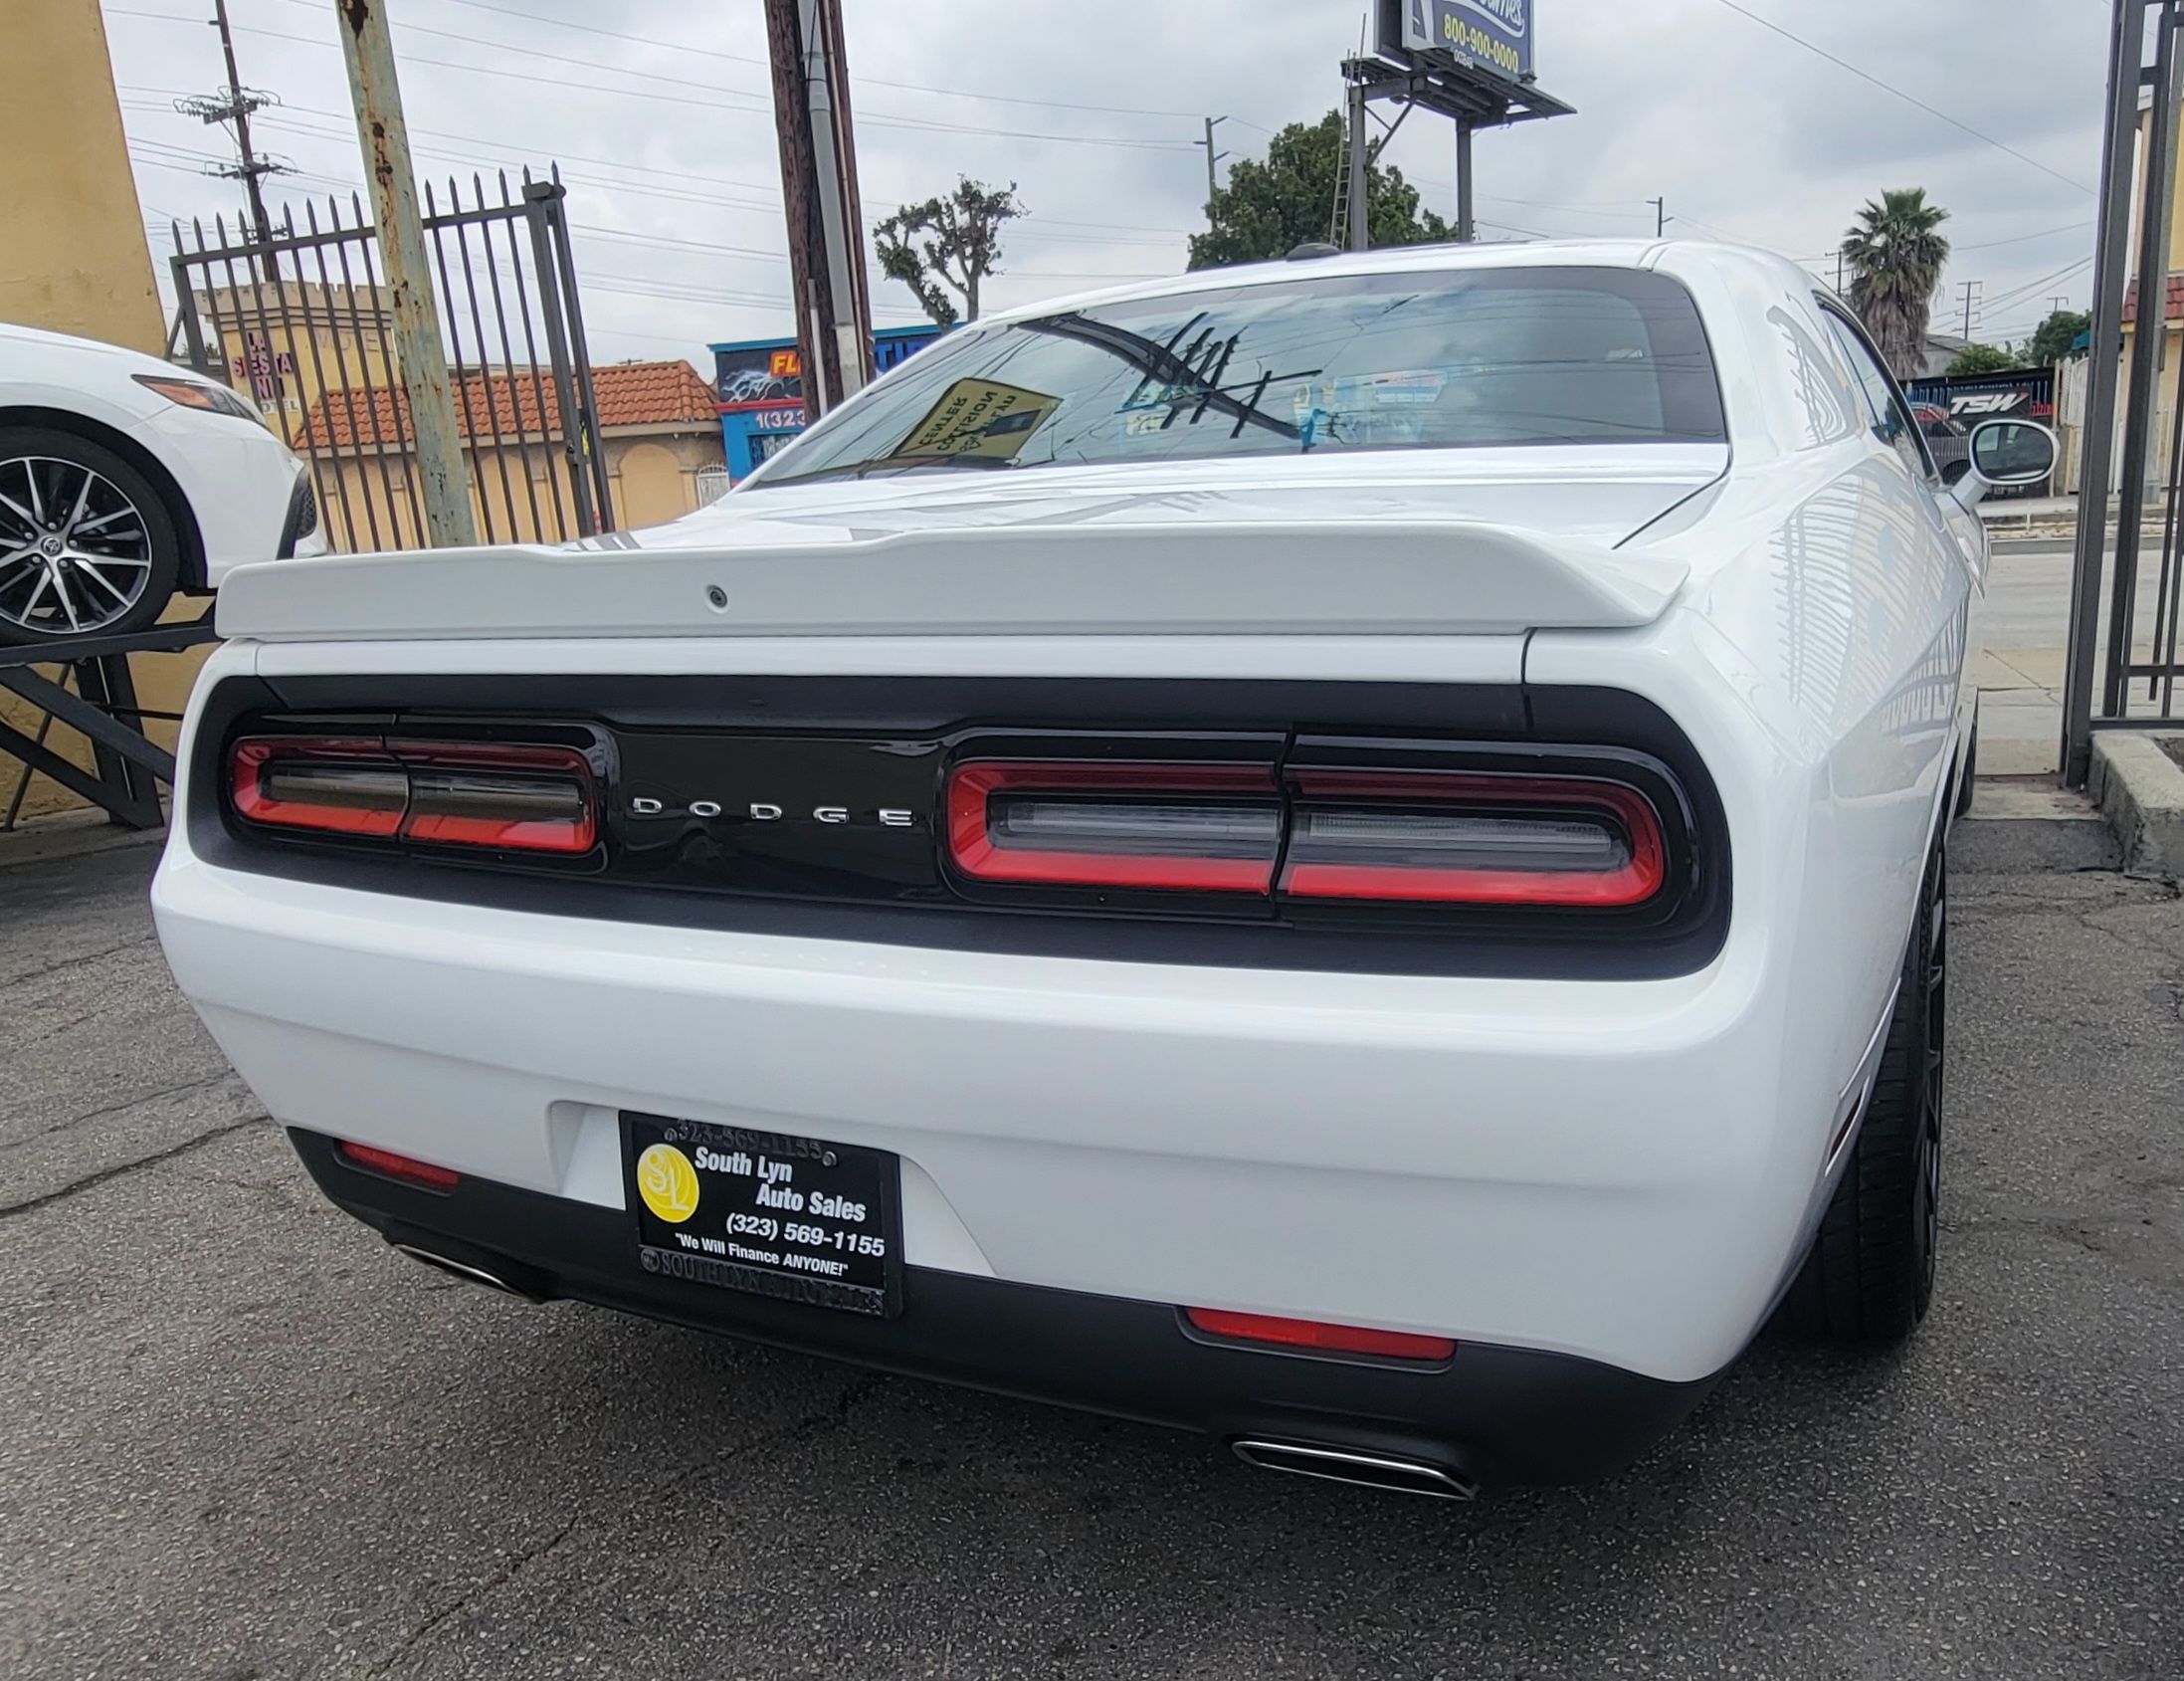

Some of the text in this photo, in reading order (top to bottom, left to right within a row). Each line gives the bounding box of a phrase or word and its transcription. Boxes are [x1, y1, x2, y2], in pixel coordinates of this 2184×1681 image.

[1445, 13, 1519, 74] 800-900-0000
[1949, 392, 2030, 414] TSW
[633, 797, 913, 827] DODGE
[678, 1119, 822, 1159] 323-569-1155
[695, 1147, 793, 1184] South Lyn
[755, 1183, 867, 1222] Auto Sales
[675, 1232, 849, 1277] "We Will Finance ANYONE!"
[725, 1213, 886, 1257] (323) 569-1155
[661, 1253, 721, 1284] SOUTH
